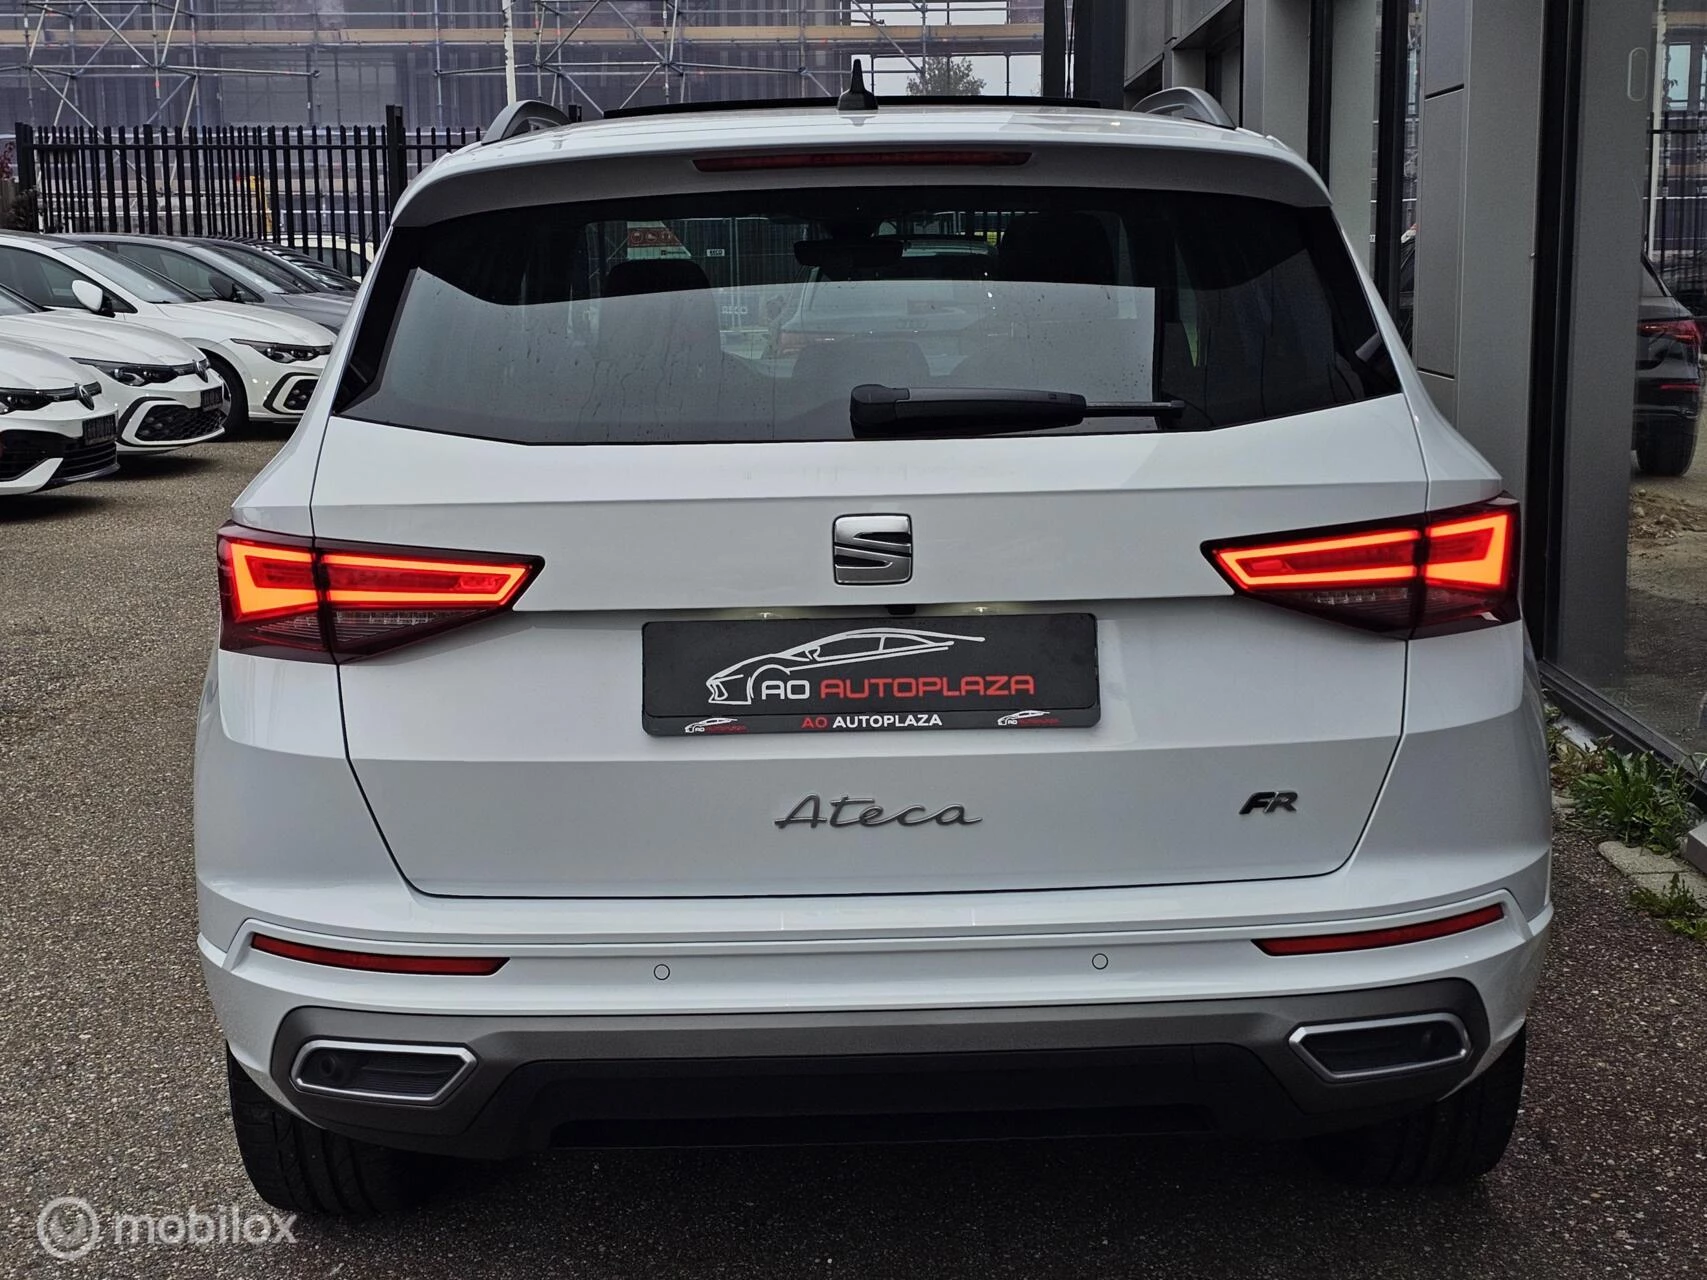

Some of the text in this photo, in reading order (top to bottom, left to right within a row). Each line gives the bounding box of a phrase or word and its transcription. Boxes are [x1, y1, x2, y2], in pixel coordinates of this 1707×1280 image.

[761, 675, 1035, 700] AO AUTOPLAZA
[801, 713, 943, 729] AO AUTOPLAZA
[775, 794, 983, 830] Ateca
[1239, 791, 1299, 815] FR
